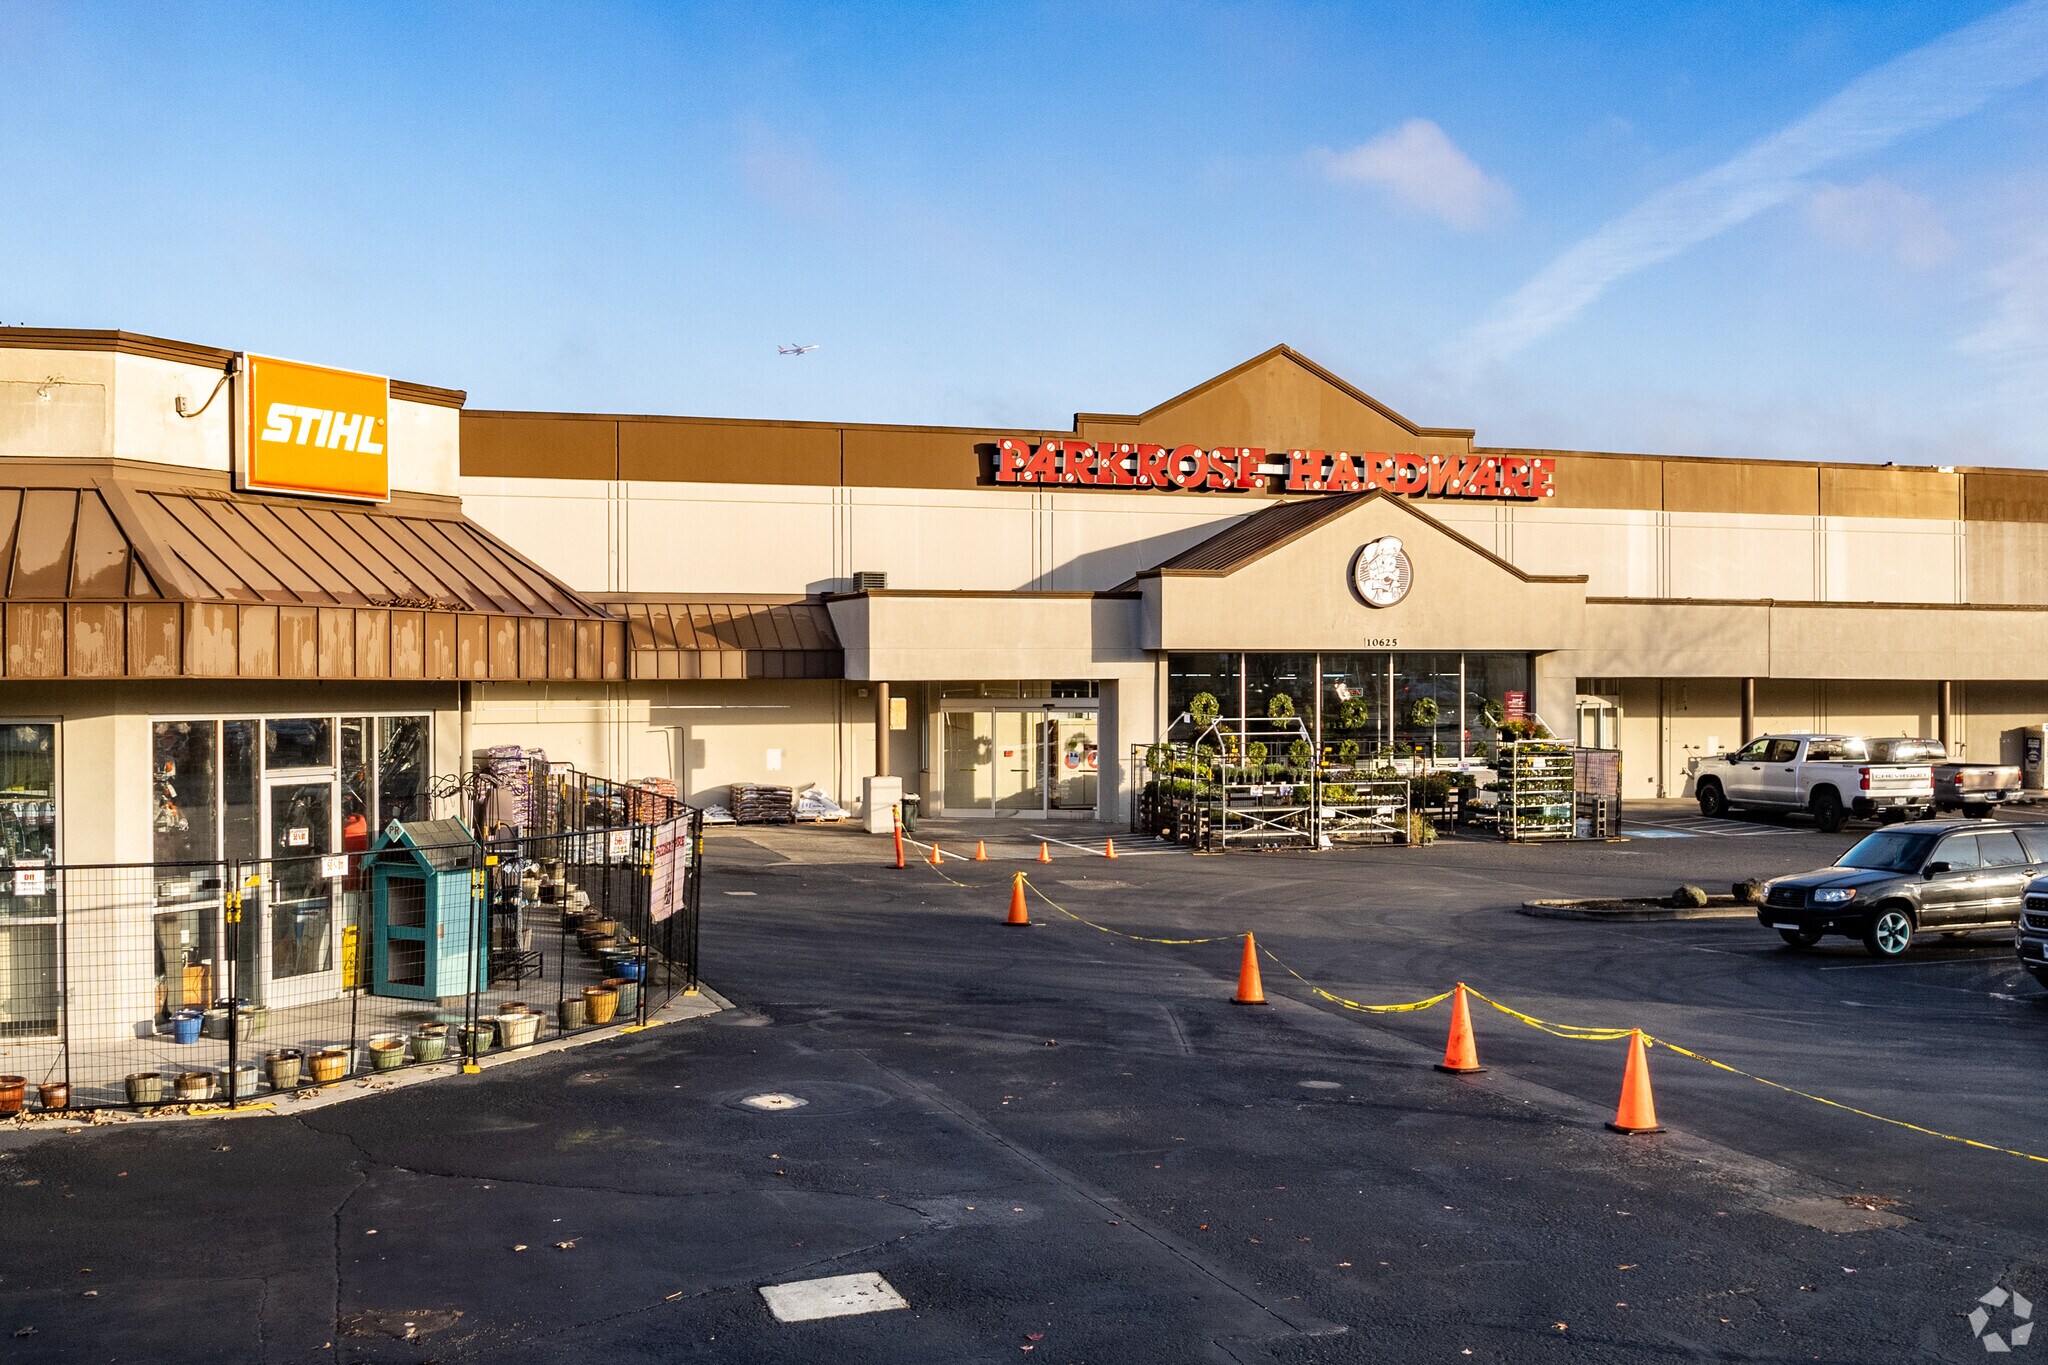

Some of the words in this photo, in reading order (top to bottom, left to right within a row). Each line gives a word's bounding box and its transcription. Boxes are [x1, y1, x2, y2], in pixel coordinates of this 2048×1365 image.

[261, 402, 384, 455] STIHL
[996, 439, 1266, 489] PARKROSE
[1286, 450, 1556, 497] HARDWARE
[1366, 638, 1398, 647] 10625
[389, 825, 400, 835] PR
